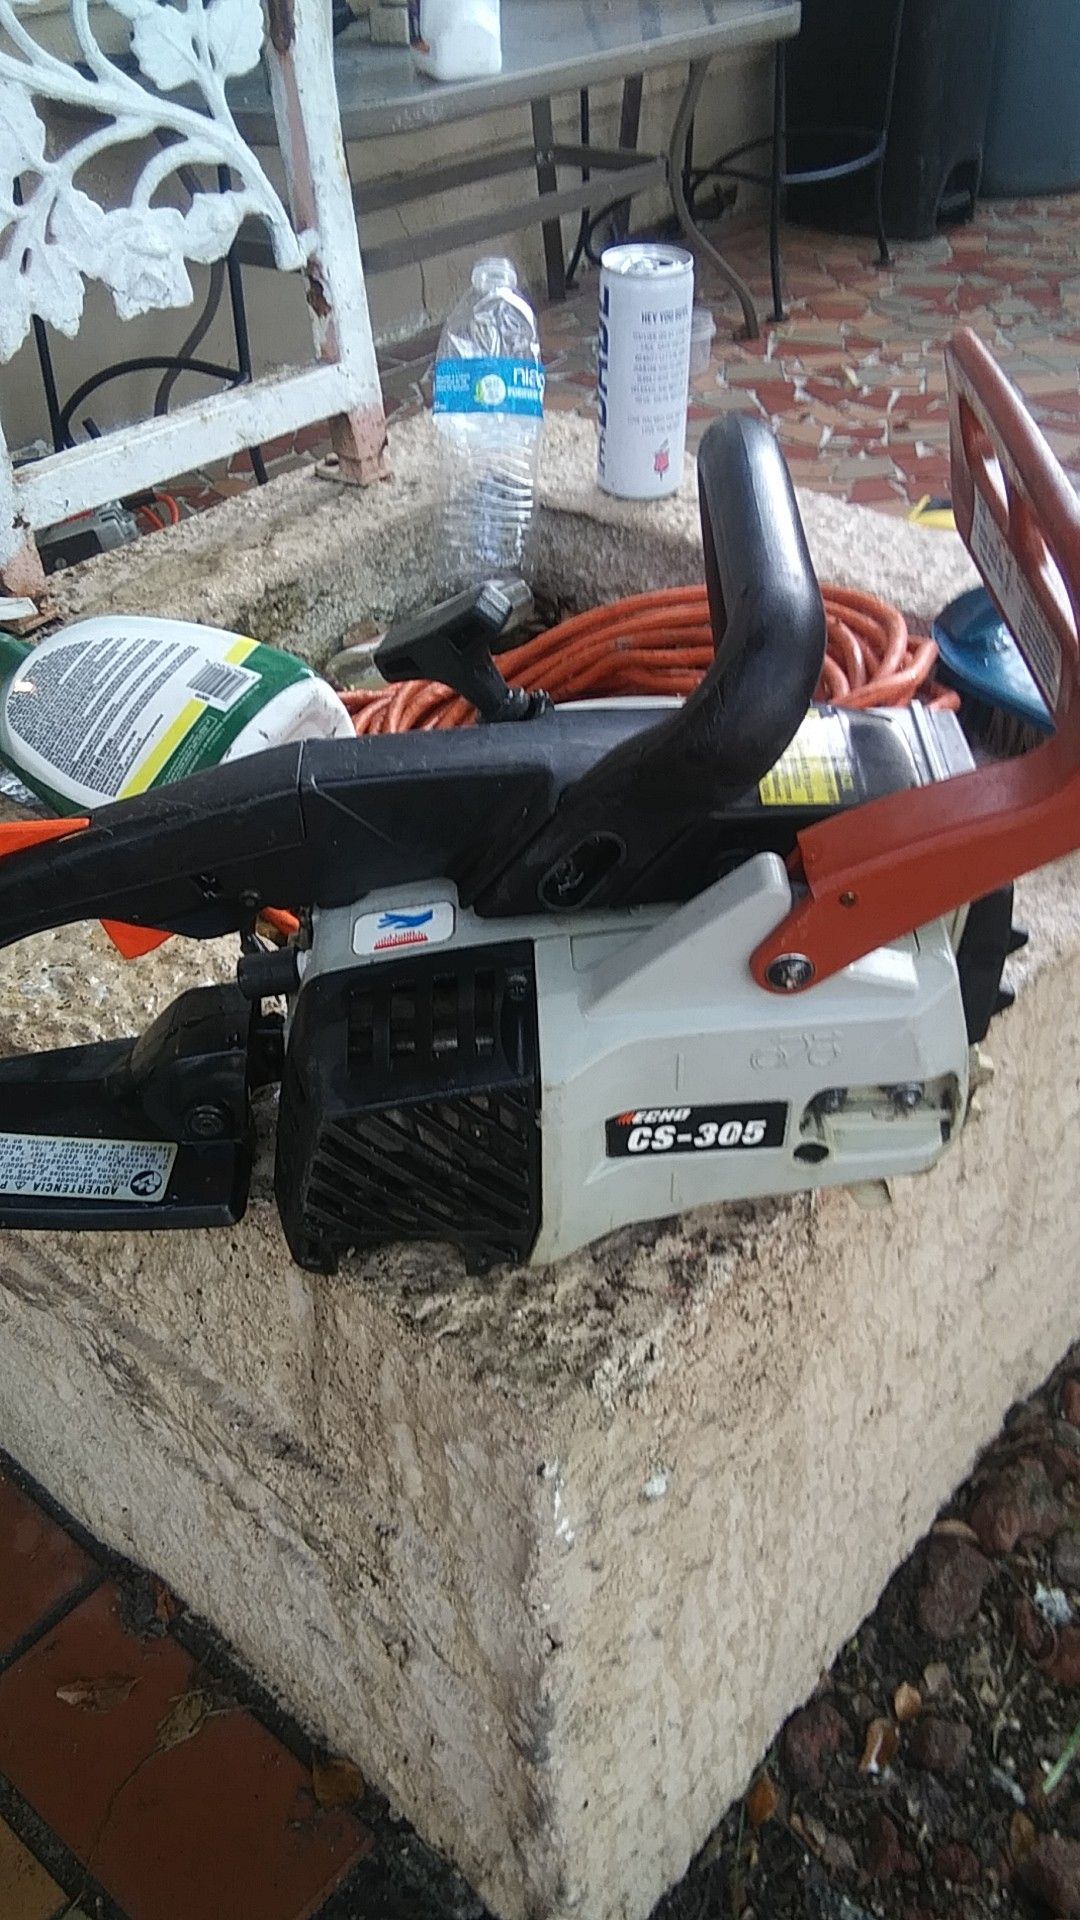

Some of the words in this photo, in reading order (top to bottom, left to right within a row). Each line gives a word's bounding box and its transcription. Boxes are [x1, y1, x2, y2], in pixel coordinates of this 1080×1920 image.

[633, 1108, 691, 1125] ECHO
[627, 1119, 767, 1152] CS-305
[33, 1182, 118, 1195] ADVERTENCIA
